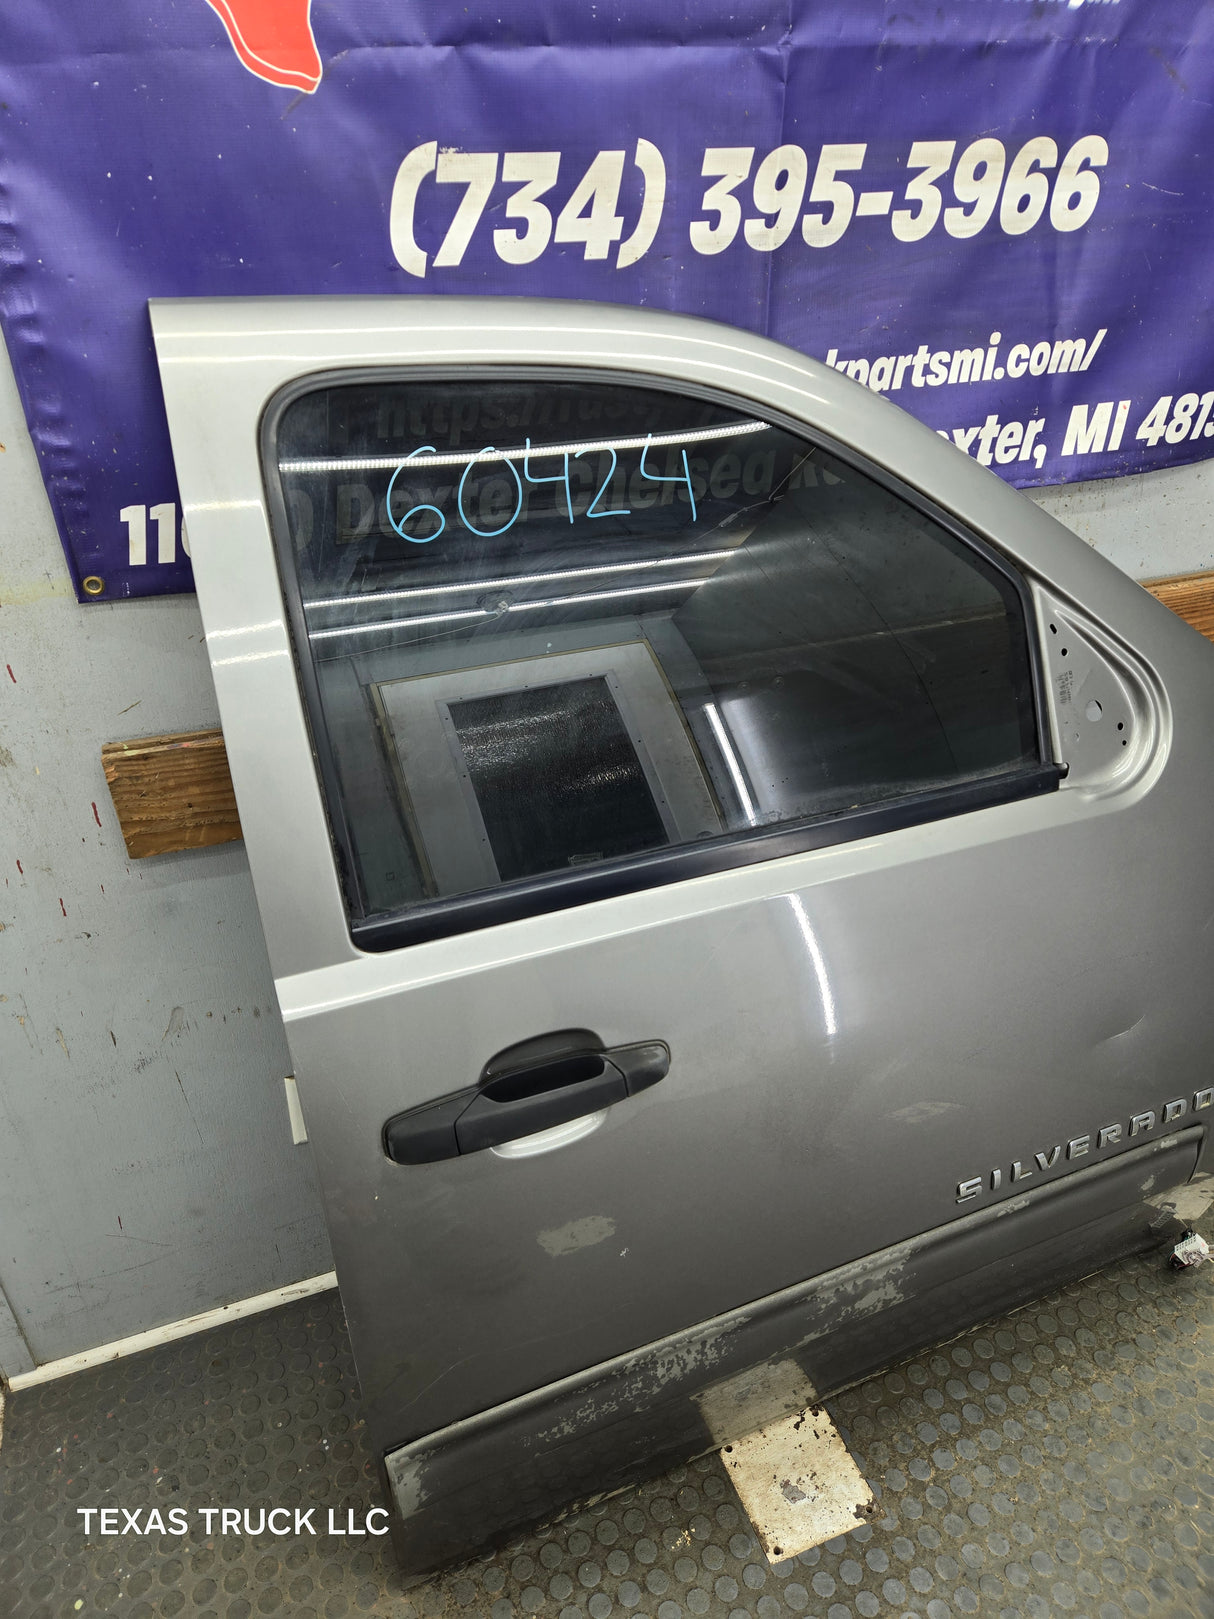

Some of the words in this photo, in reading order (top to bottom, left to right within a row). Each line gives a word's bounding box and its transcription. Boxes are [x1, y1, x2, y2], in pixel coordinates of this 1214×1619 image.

[389, 137, 666, 278] (734)
[689, 135, 1108, 255] 395-3966
[120, 503, 191, 565] 11
[936, 415, 1047, 469] xter,
[1061, 400, 1131, 456] MI
[386, 433, 697, 543] 60424
[956, 1086, 1214, 1204] SILVERADO
